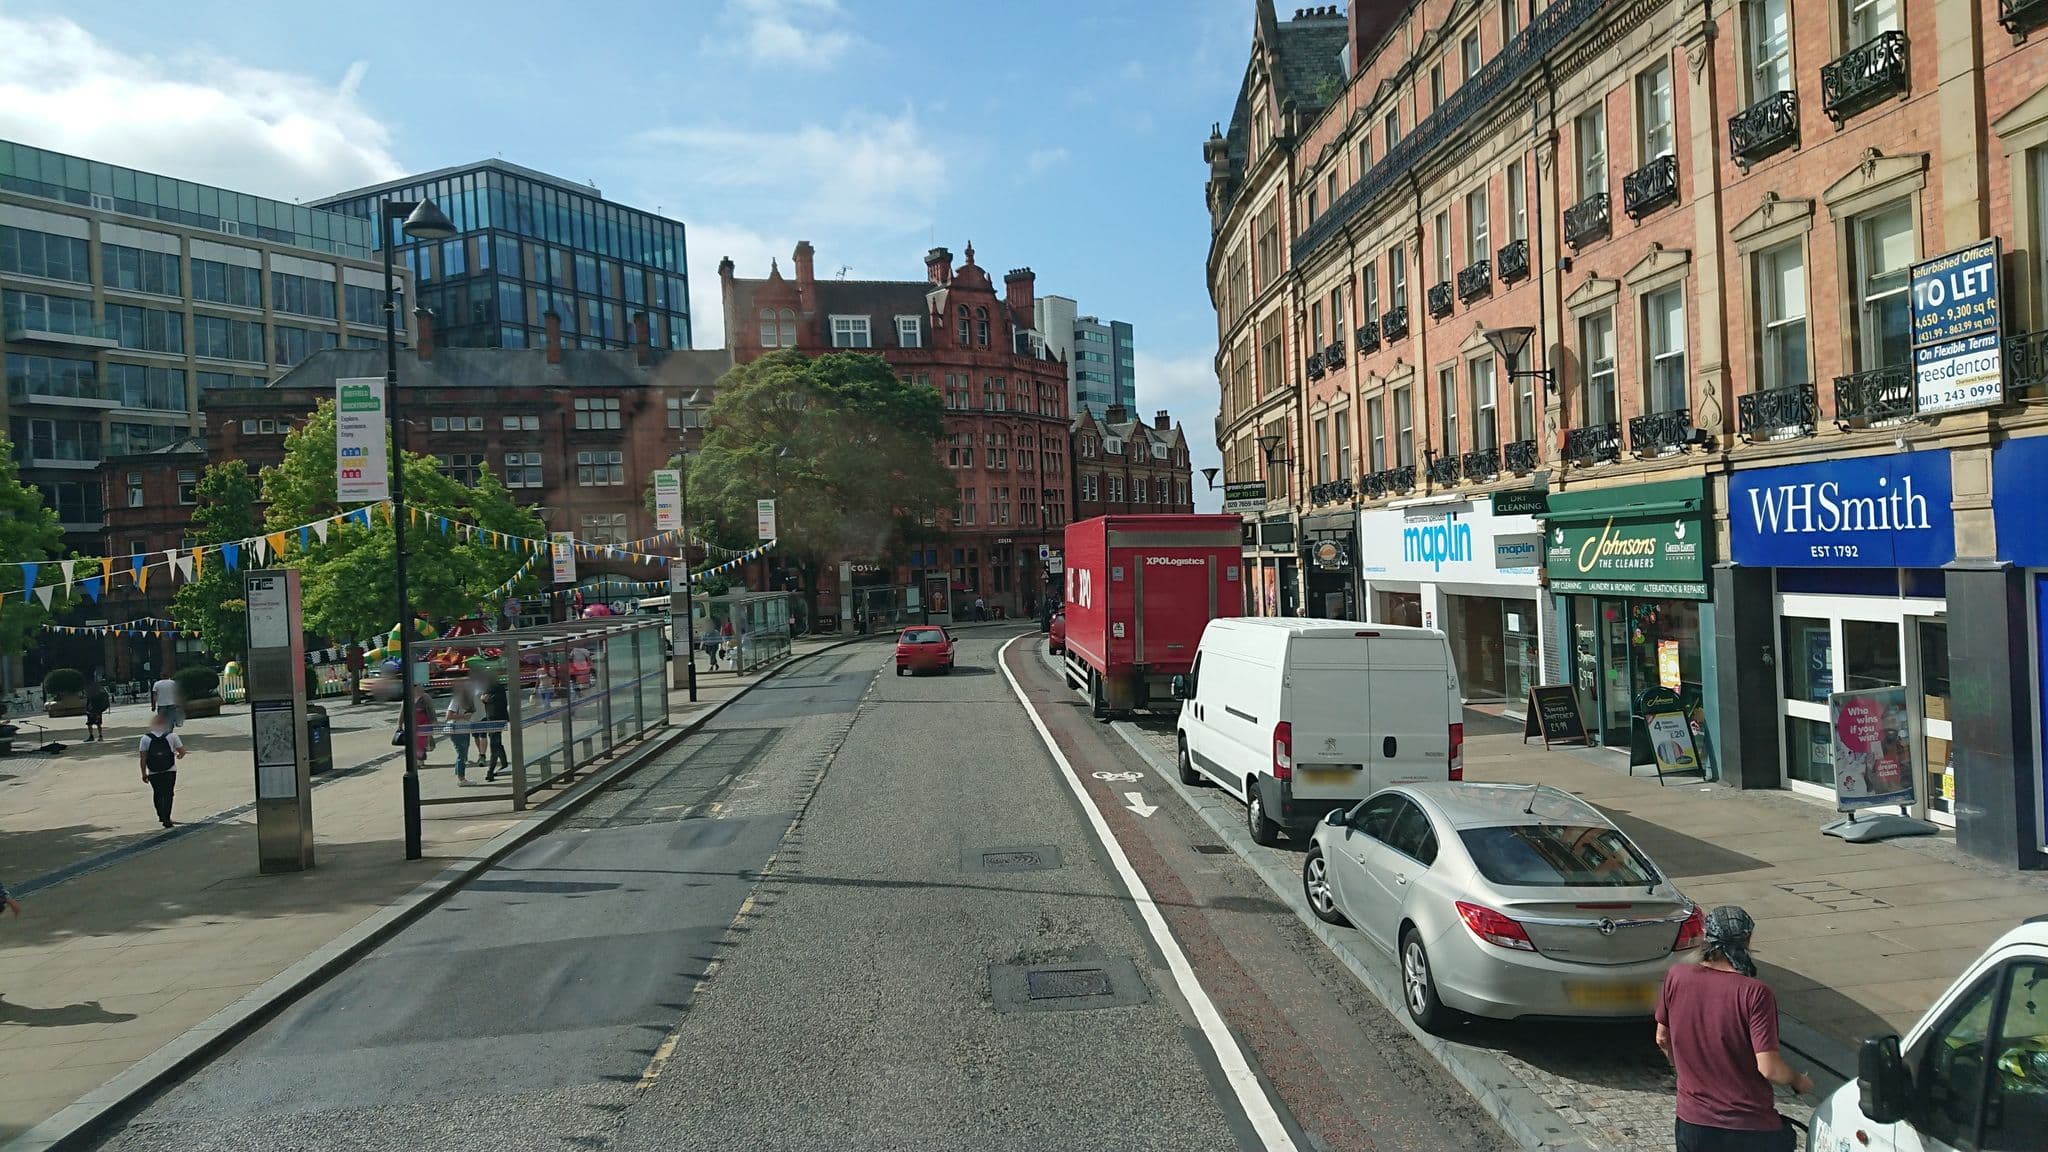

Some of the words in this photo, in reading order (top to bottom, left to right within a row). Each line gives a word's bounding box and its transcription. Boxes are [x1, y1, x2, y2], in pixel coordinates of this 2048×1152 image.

[1914, 255, 1960, 278] Refurbished
[1962, 247, 1994, 263] Offices
[1915, 278, 1945, 310] TO
[1951, 263, 1993, 300] LET
[1947, 304, 1972, 321] 9,300
[1973, 303, 1985, 314] sq
[1986, 297, 1996, 310] ft
[1920, 349, 1932, 361] On
[1934, 341, 1966, 358] Flexible
[1968, 335, 1996, 350] Terms
[1919, 356, 2000, 382] reesdenton
[1919, 393, 1939, 406] 0113
[1944, 389, 1965, 402] 243
[1970, 382, 2001, 397] 0990
[1498, 503, 1541, 511] CLEANING
[1748, 476, 1931, 534] WHSmith
[1404, 512, 1472, 572] maplin
[1579, 515, 1656, 572] Johnsons
[1498, 543, 1535, 555] maplin
[1811, 546, 1829, 557] EST
[1834, 545, 1858, 557] 1792
[851, 564, 880, 572] COSTA
[1600, 560, 1612, 568] THE
[1616, 559, 1654, 568] CLEANERS
[1561, 582, 1582, 590] CLEANING
[1643, 584, 1678, 592] ALTERATIONS
[1683, 585, 1704, 593] REPAIRS
[1848, 707, 1869, 717] Who
[1654, 721, 1661, 731] 4
[1857, 716, 1878, 724] wins
[1850, 725, 1857, 734] if
[1858, 726, 1875, 736] you
[1858, 731, 1879, 742] win?
